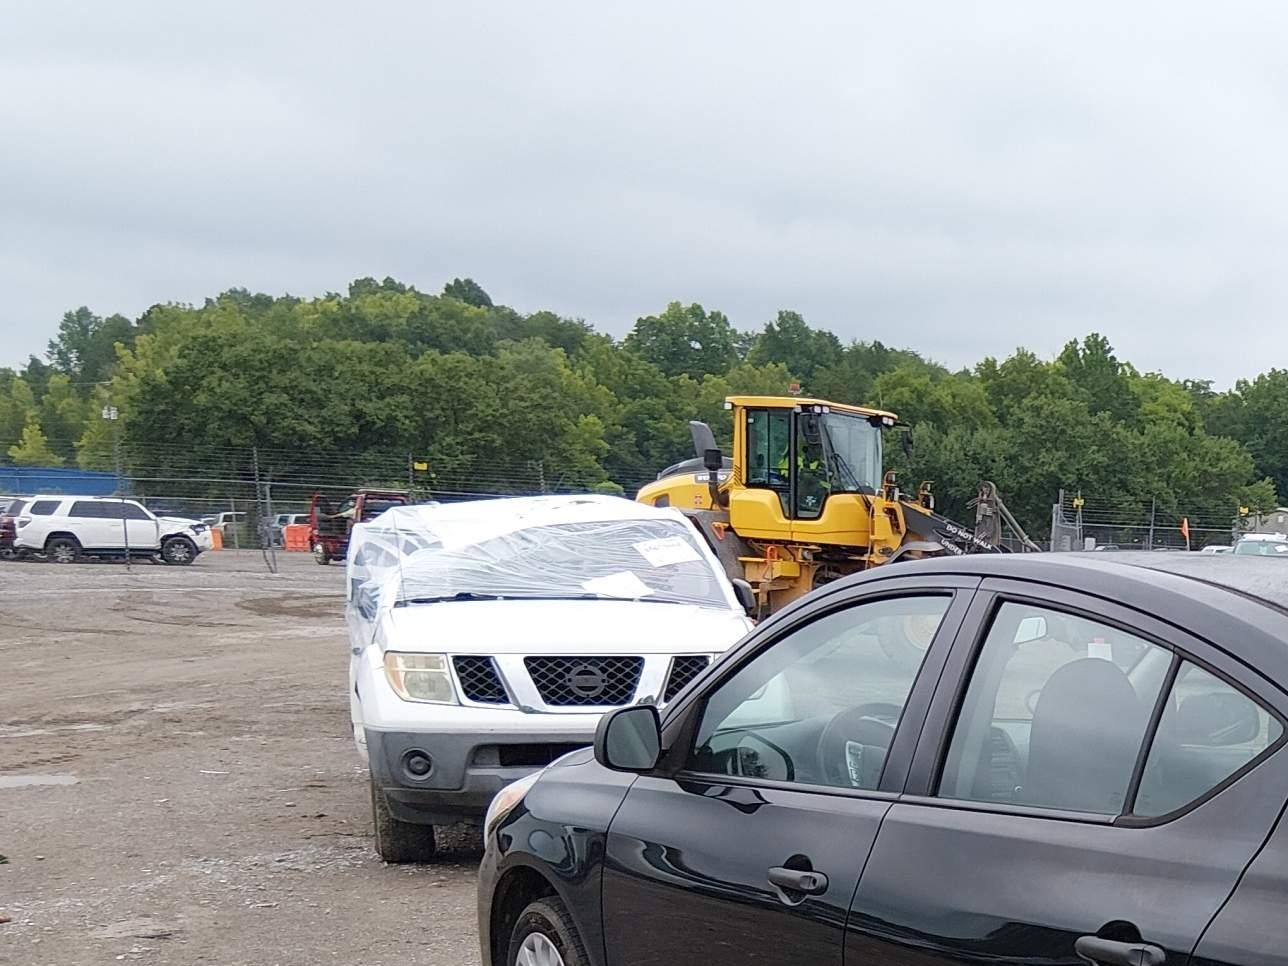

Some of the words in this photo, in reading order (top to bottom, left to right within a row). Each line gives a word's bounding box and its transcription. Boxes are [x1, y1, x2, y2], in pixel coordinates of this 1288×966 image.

[946, 524, 957, 533] DO
[958, 530, 973, 540] NOT
[973, 538, 992, 550] WALK
